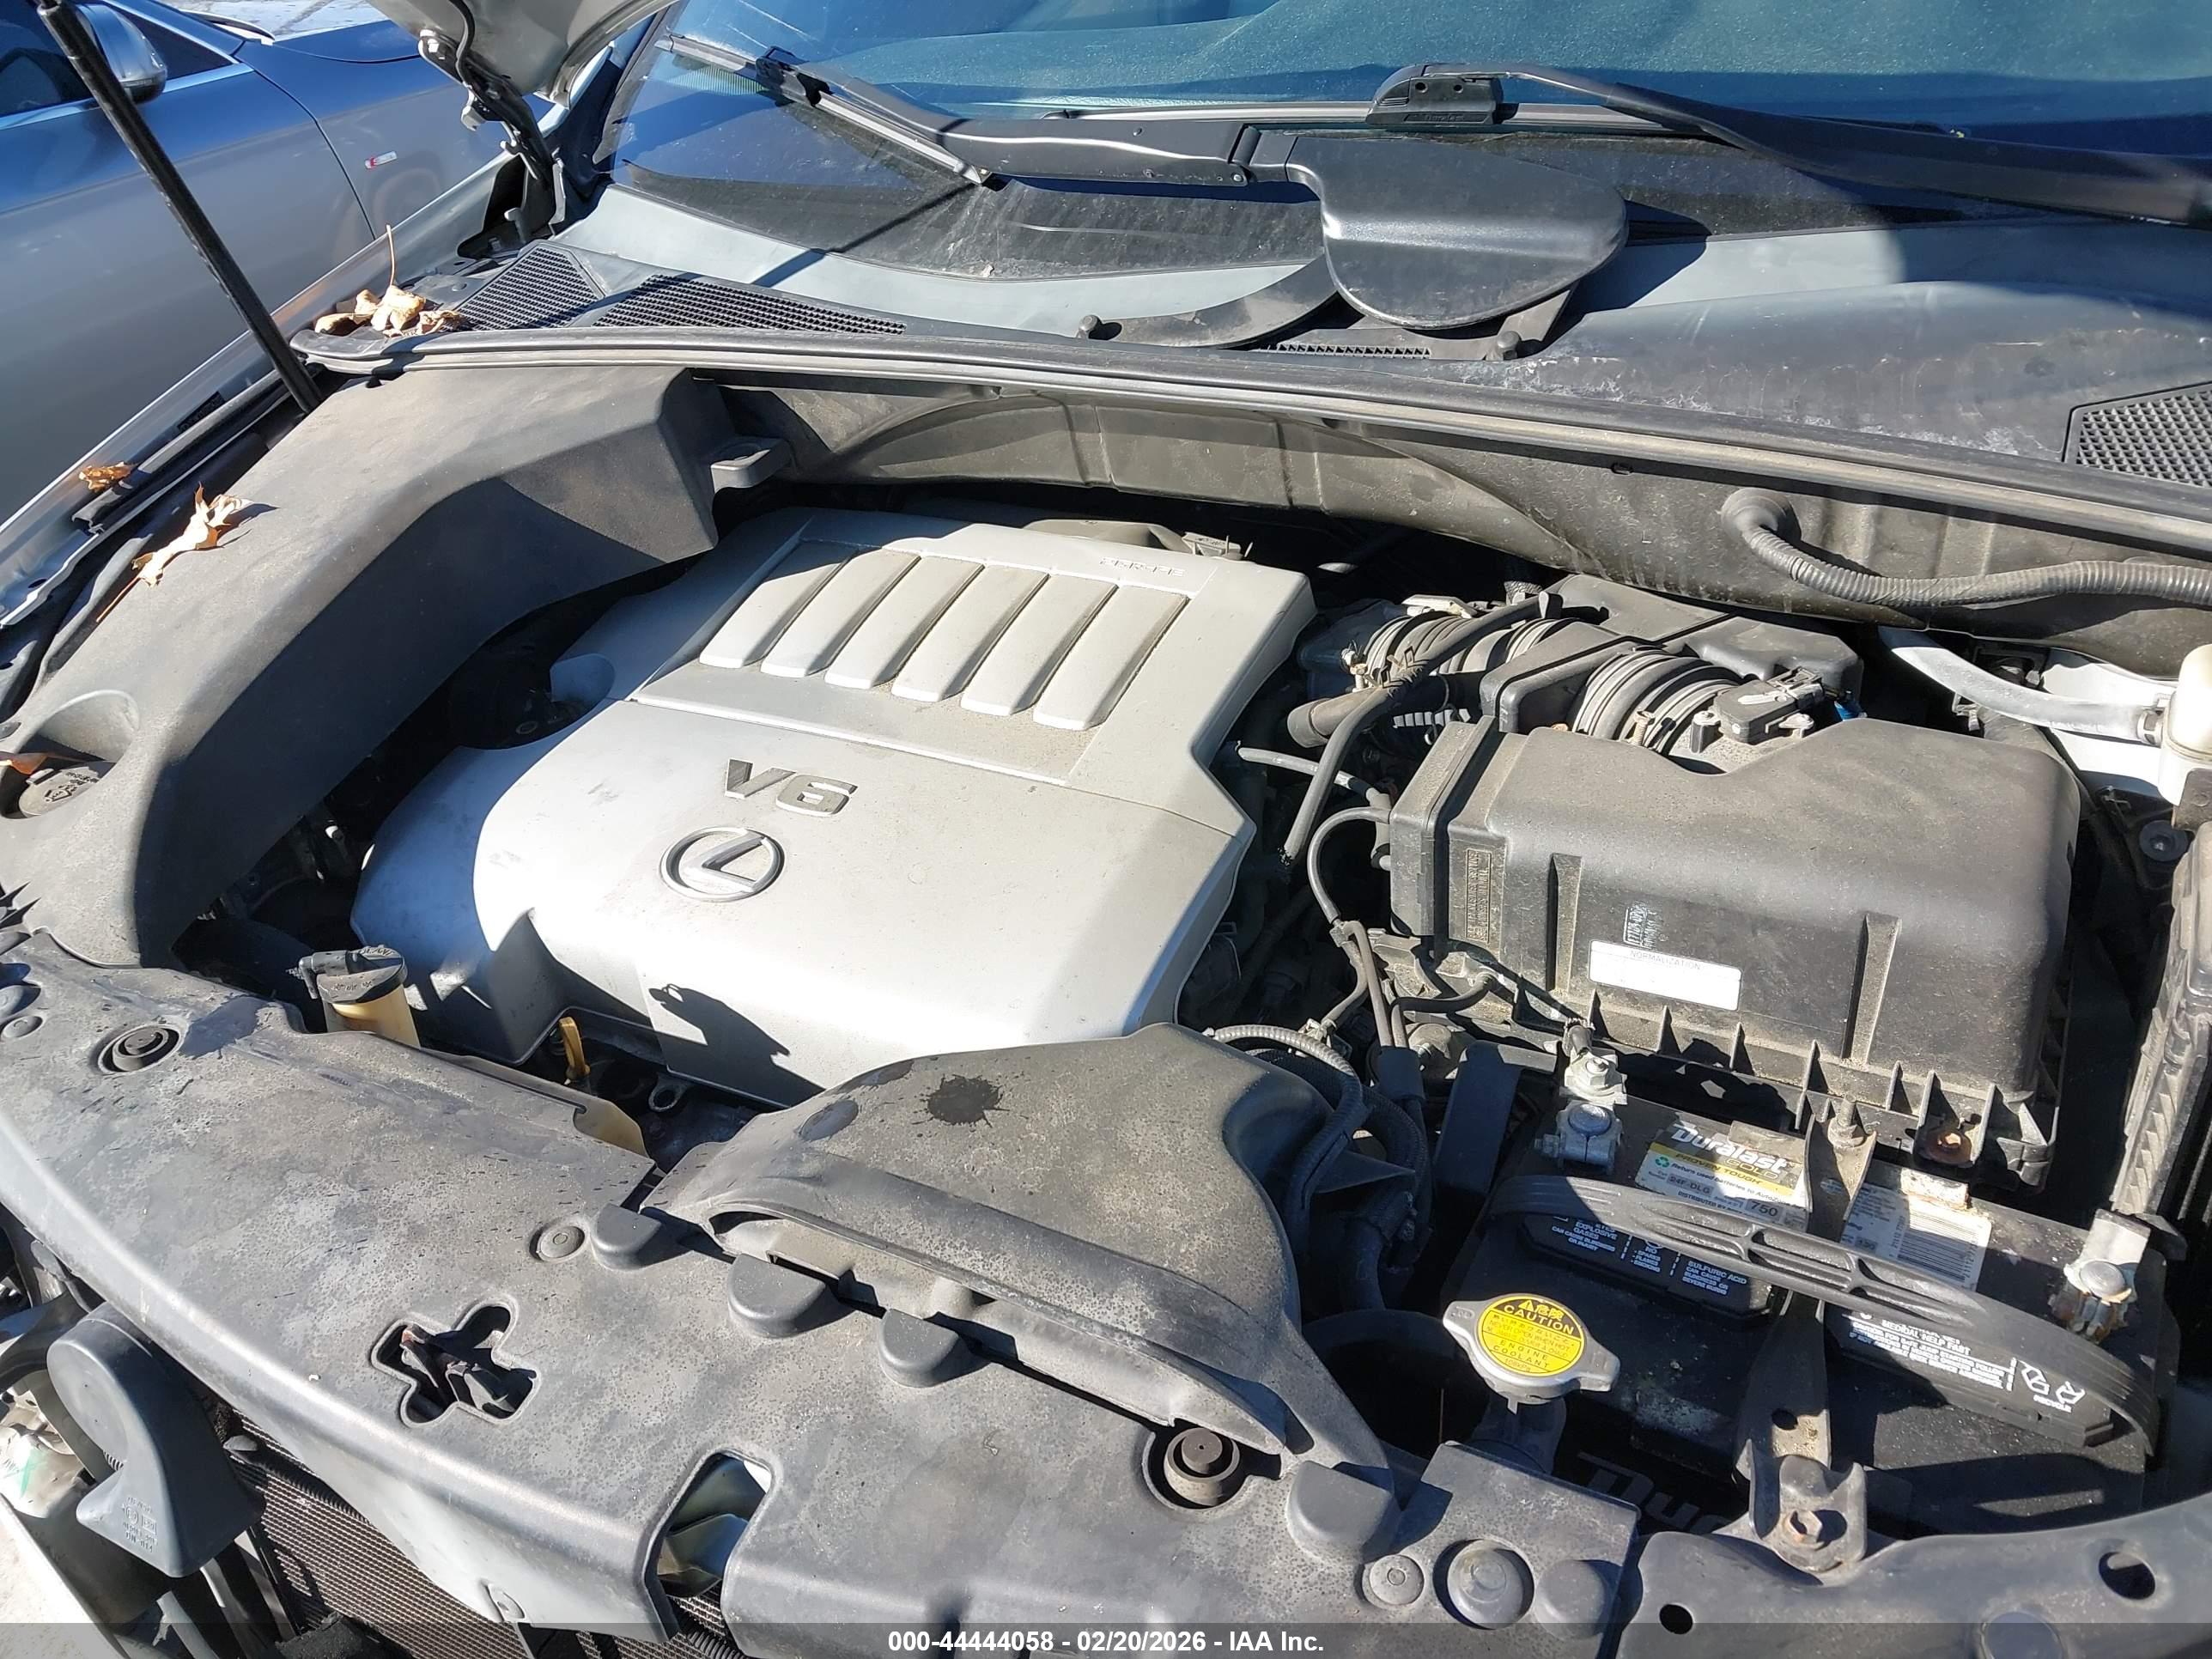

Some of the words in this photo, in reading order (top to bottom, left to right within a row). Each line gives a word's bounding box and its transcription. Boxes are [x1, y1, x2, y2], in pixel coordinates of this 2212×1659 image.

[725, 759, 858, 817] V6
[1671, 1120, 1788, 1174] Duralast
[1675, 1152, 1720, 1171] PROVEN
[1723, 1168, 1763, 1185] TOUGH
[1724, 1158, 1779, 1180] GOLD
[1751, 1201, 1778, 1217] 750
[1573, 1226, 1600, 1240] GASES
[1575, 1221, 1618, 1241] EXPLOSIVE
[1645, 1245, 1658, 1254] NO
[1687, 1260, 1727, 1279] SULFURIC
[1727, 1273, 1747, 1285] ACID
[1504, 1304, 1575, 1335] CAUTION
[1534, 1303, 1565, 1322] 危険
[1492, 1345, 1550, 1369] COOLANT
[1499, 1340, 1549, 1361] ENGINE
[2033, 1394, 2073, 1413] RECYCLE
